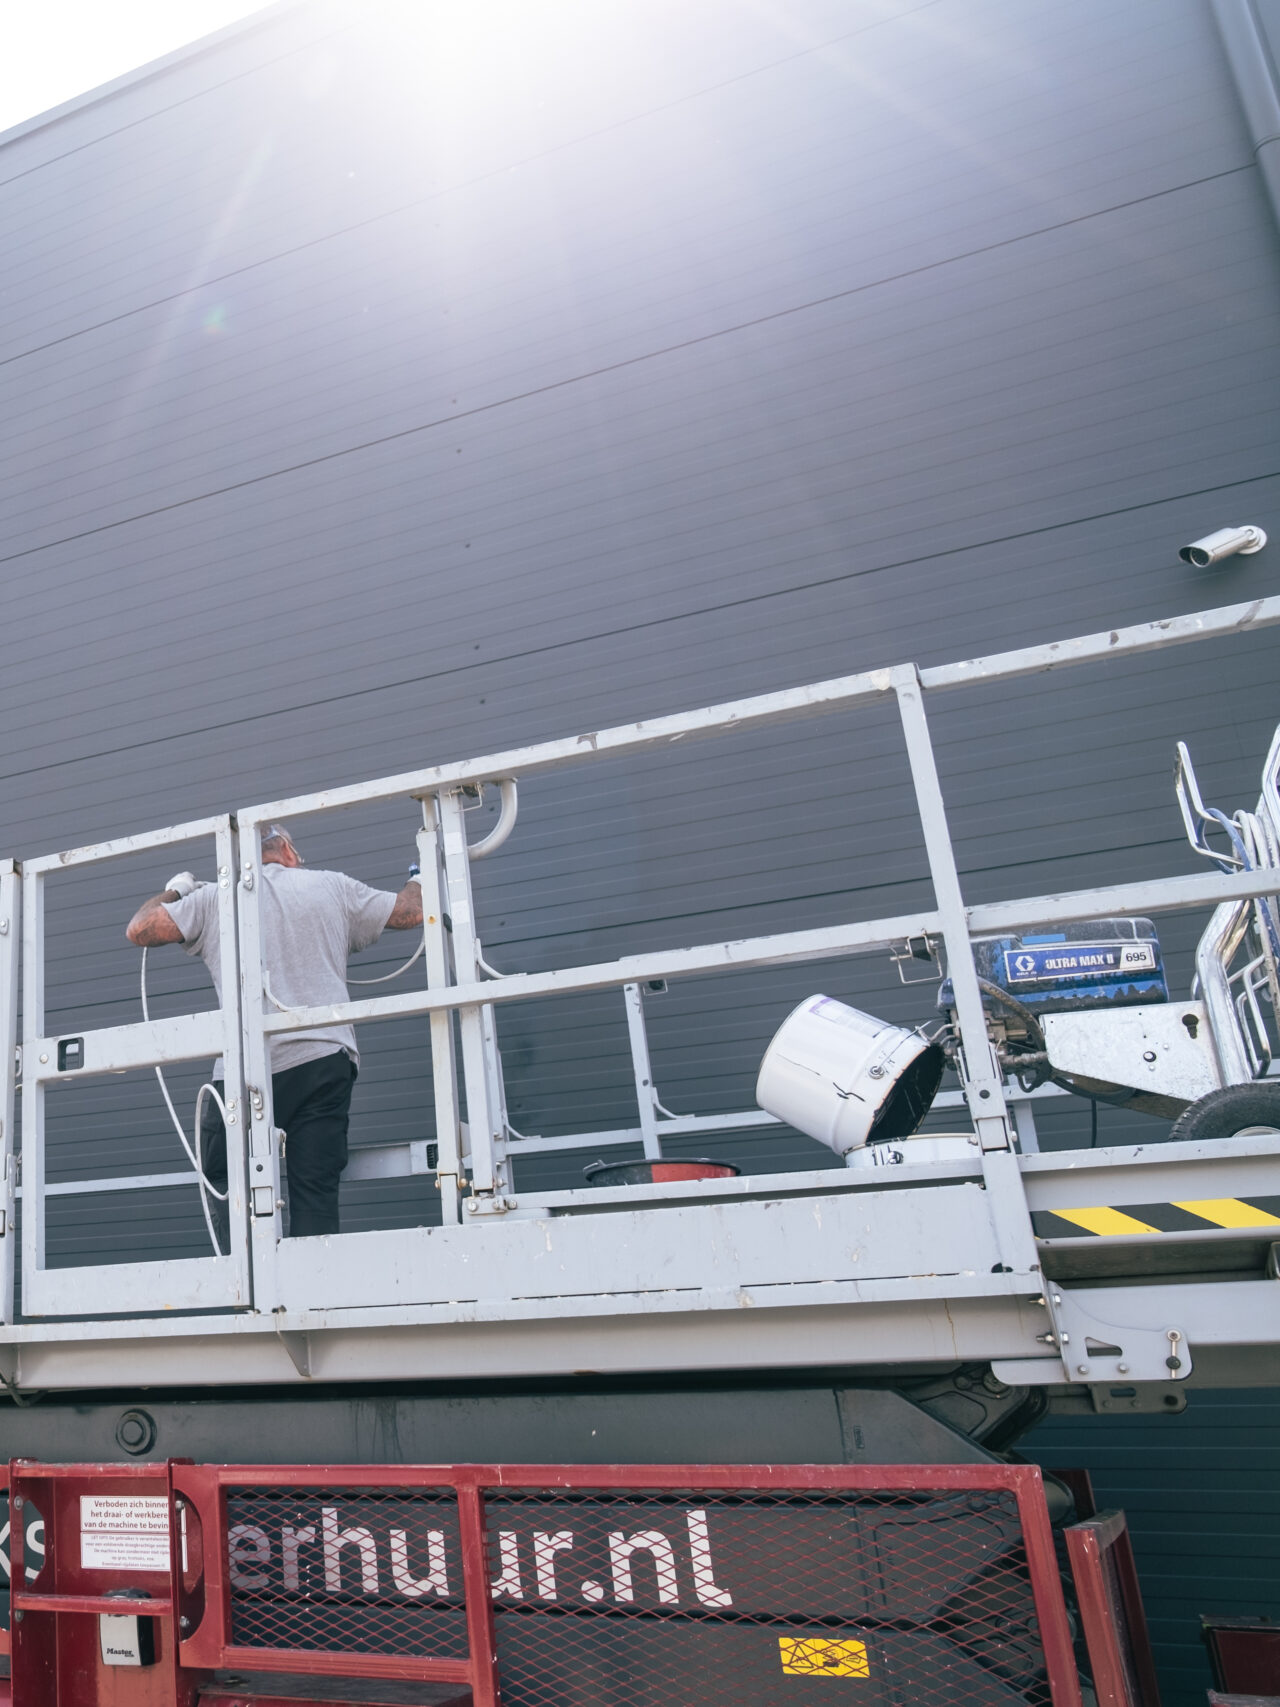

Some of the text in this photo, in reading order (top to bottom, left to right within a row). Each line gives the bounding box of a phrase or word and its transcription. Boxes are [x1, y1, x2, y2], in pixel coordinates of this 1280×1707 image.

[1046, 953, 1114, 969] ULTRA MAX II
[1126, 952, 1147, 962] 695
[91, 1510, 103, 1518] het
[134, 1511, 169, 1519] werkbere
[108, 1521, 138, 1529] machine
[148, 1521, 169, 1529] bevin
